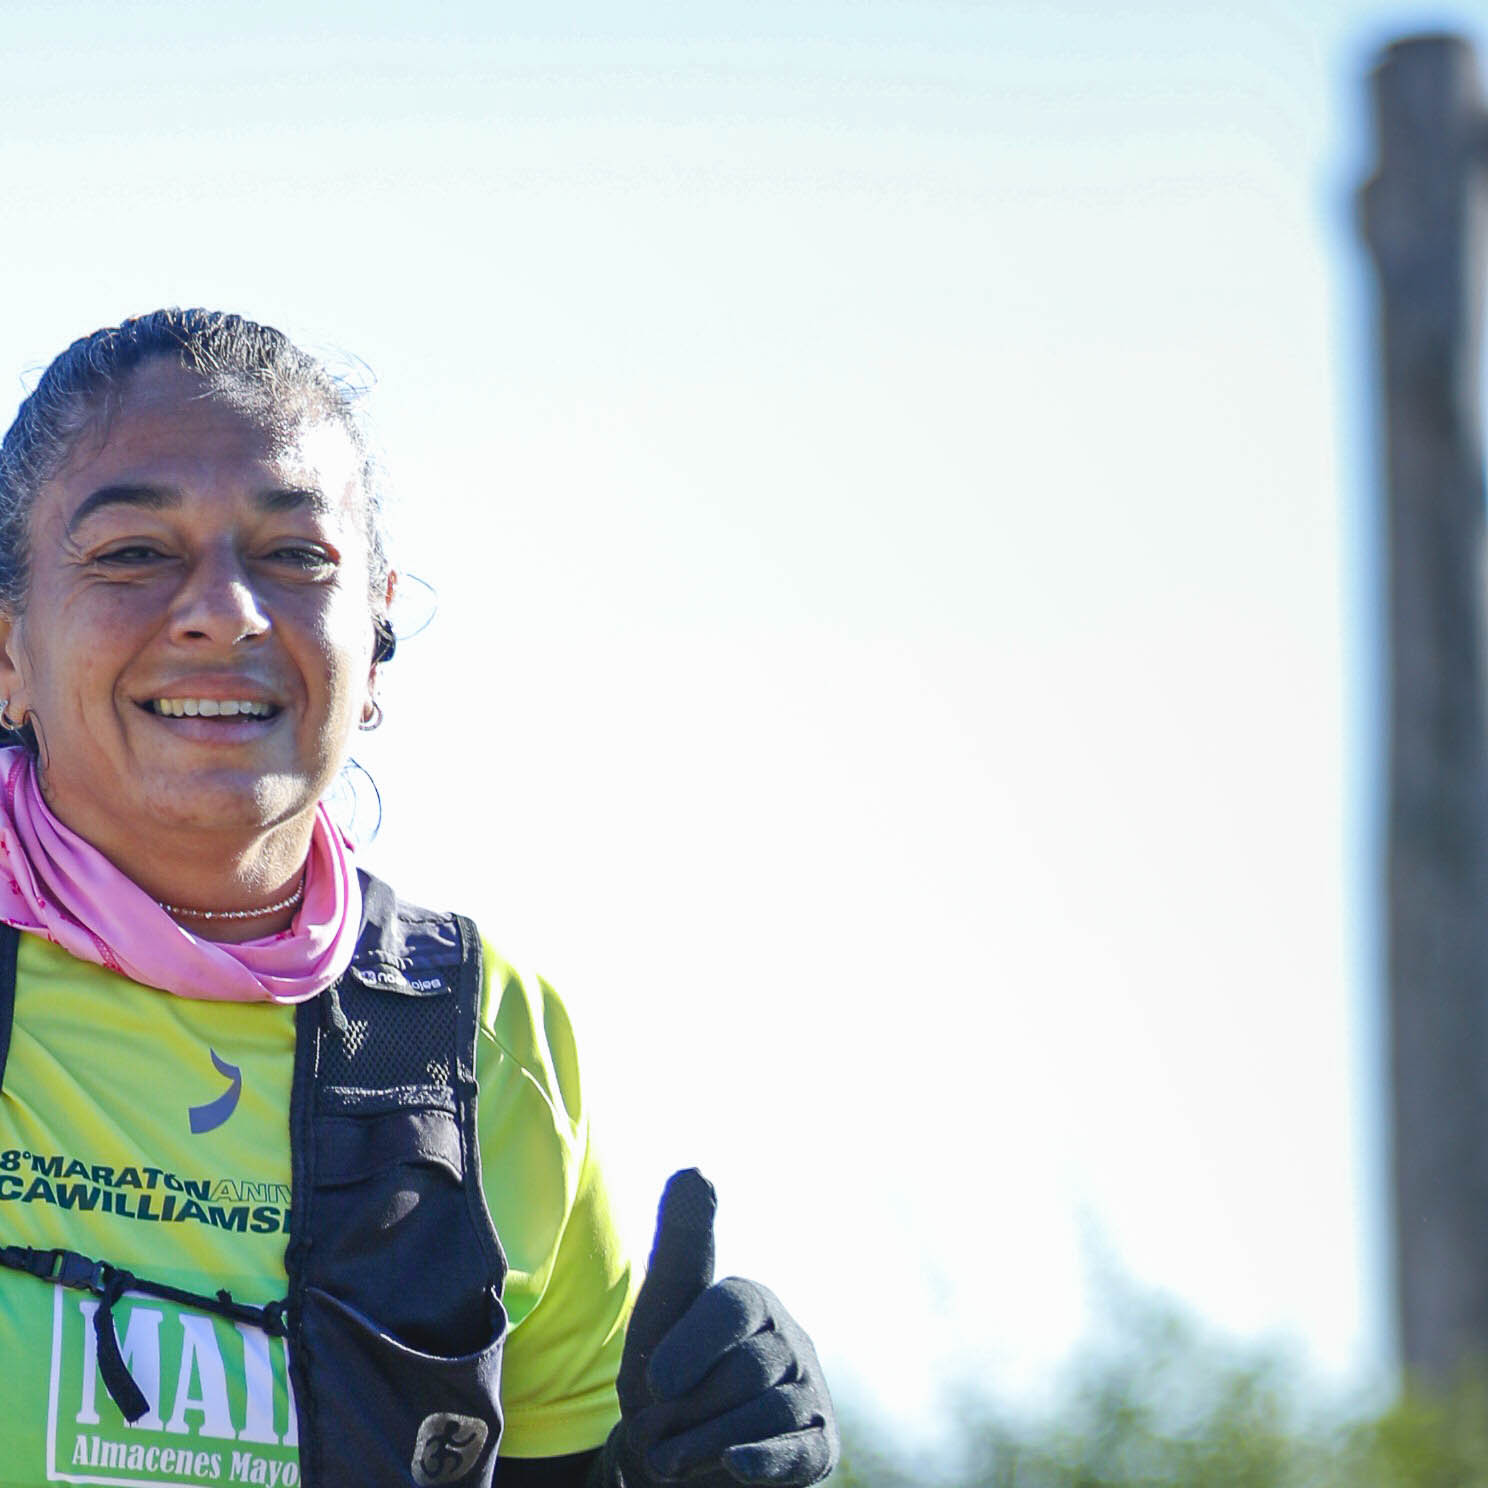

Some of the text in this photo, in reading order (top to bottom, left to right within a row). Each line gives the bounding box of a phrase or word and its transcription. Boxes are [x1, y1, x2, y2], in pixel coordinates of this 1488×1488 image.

[75, 1300, 300, 1447] MAI
[72, 1434, 301, 1488] Almacenes Mayo
